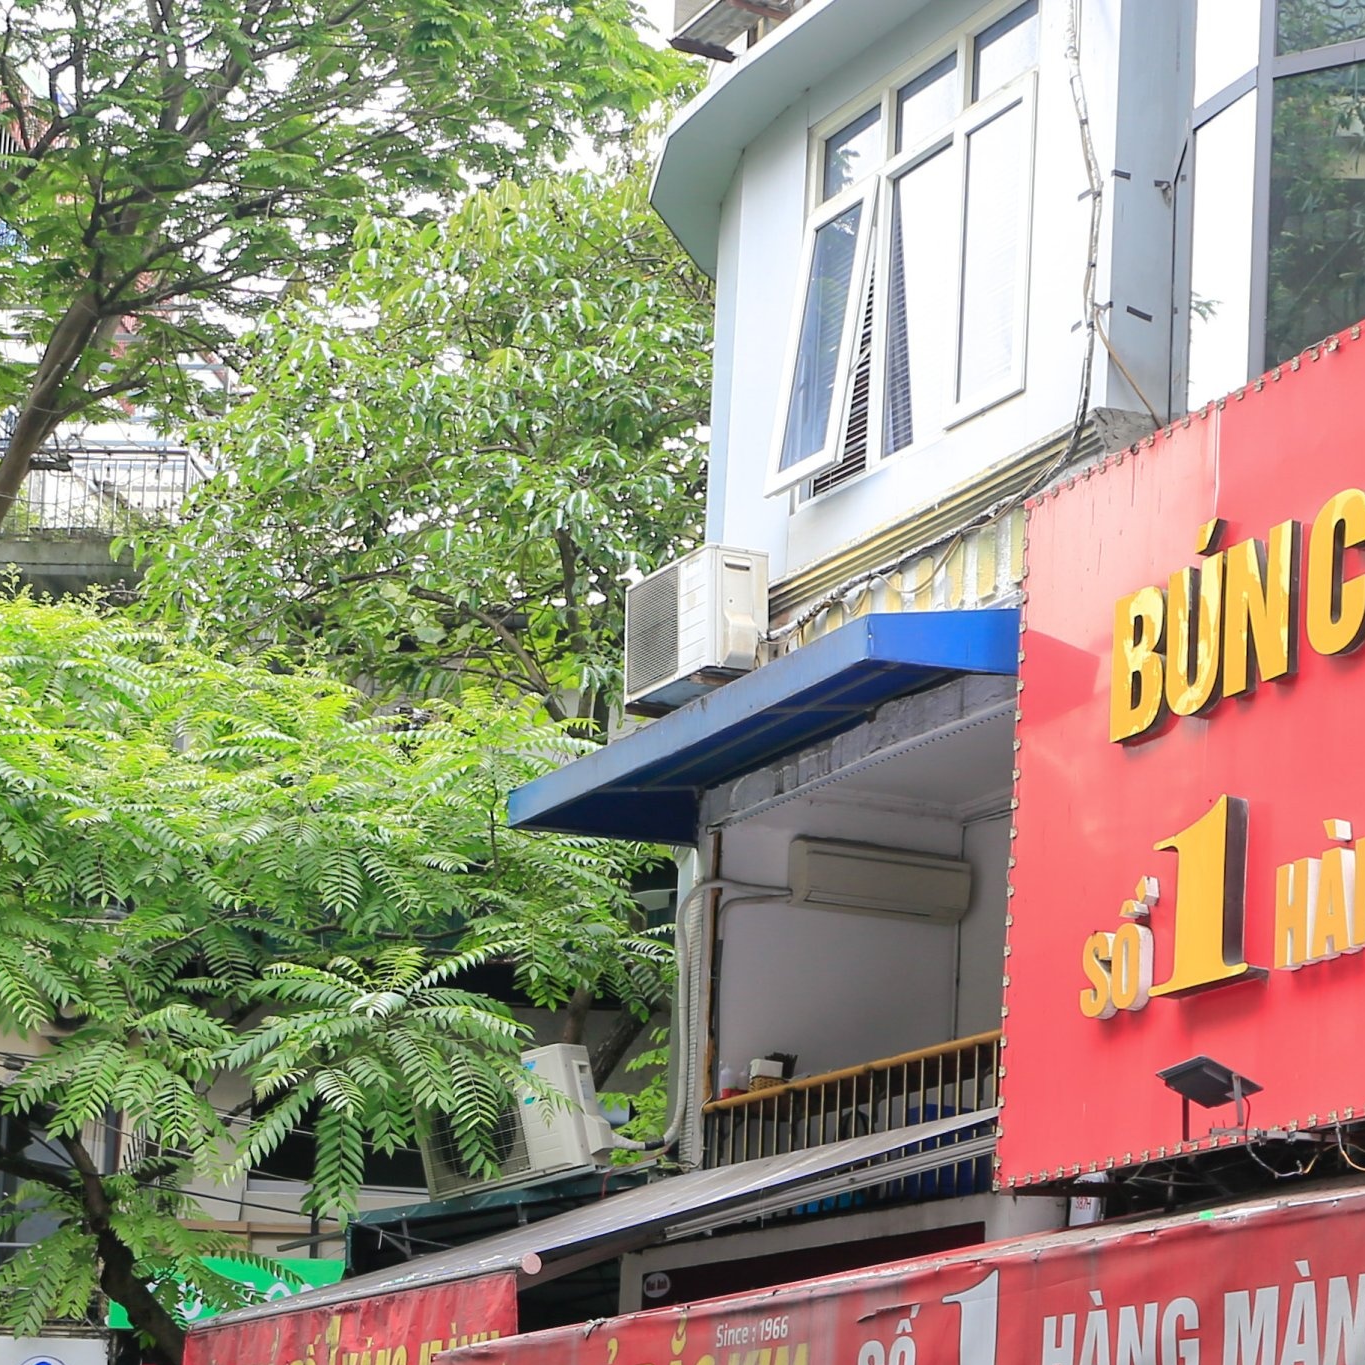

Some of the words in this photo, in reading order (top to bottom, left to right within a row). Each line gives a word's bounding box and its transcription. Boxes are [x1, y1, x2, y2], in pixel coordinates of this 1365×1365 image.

[1110, 518, 1299, 745] BÚN
[1079, 875, 1160, 1021] SỐ
[1148, 793, 1257, 999] 1
[715, 1321, 749, 1349] Since
[758, 1315, 790, 1342] 1966
